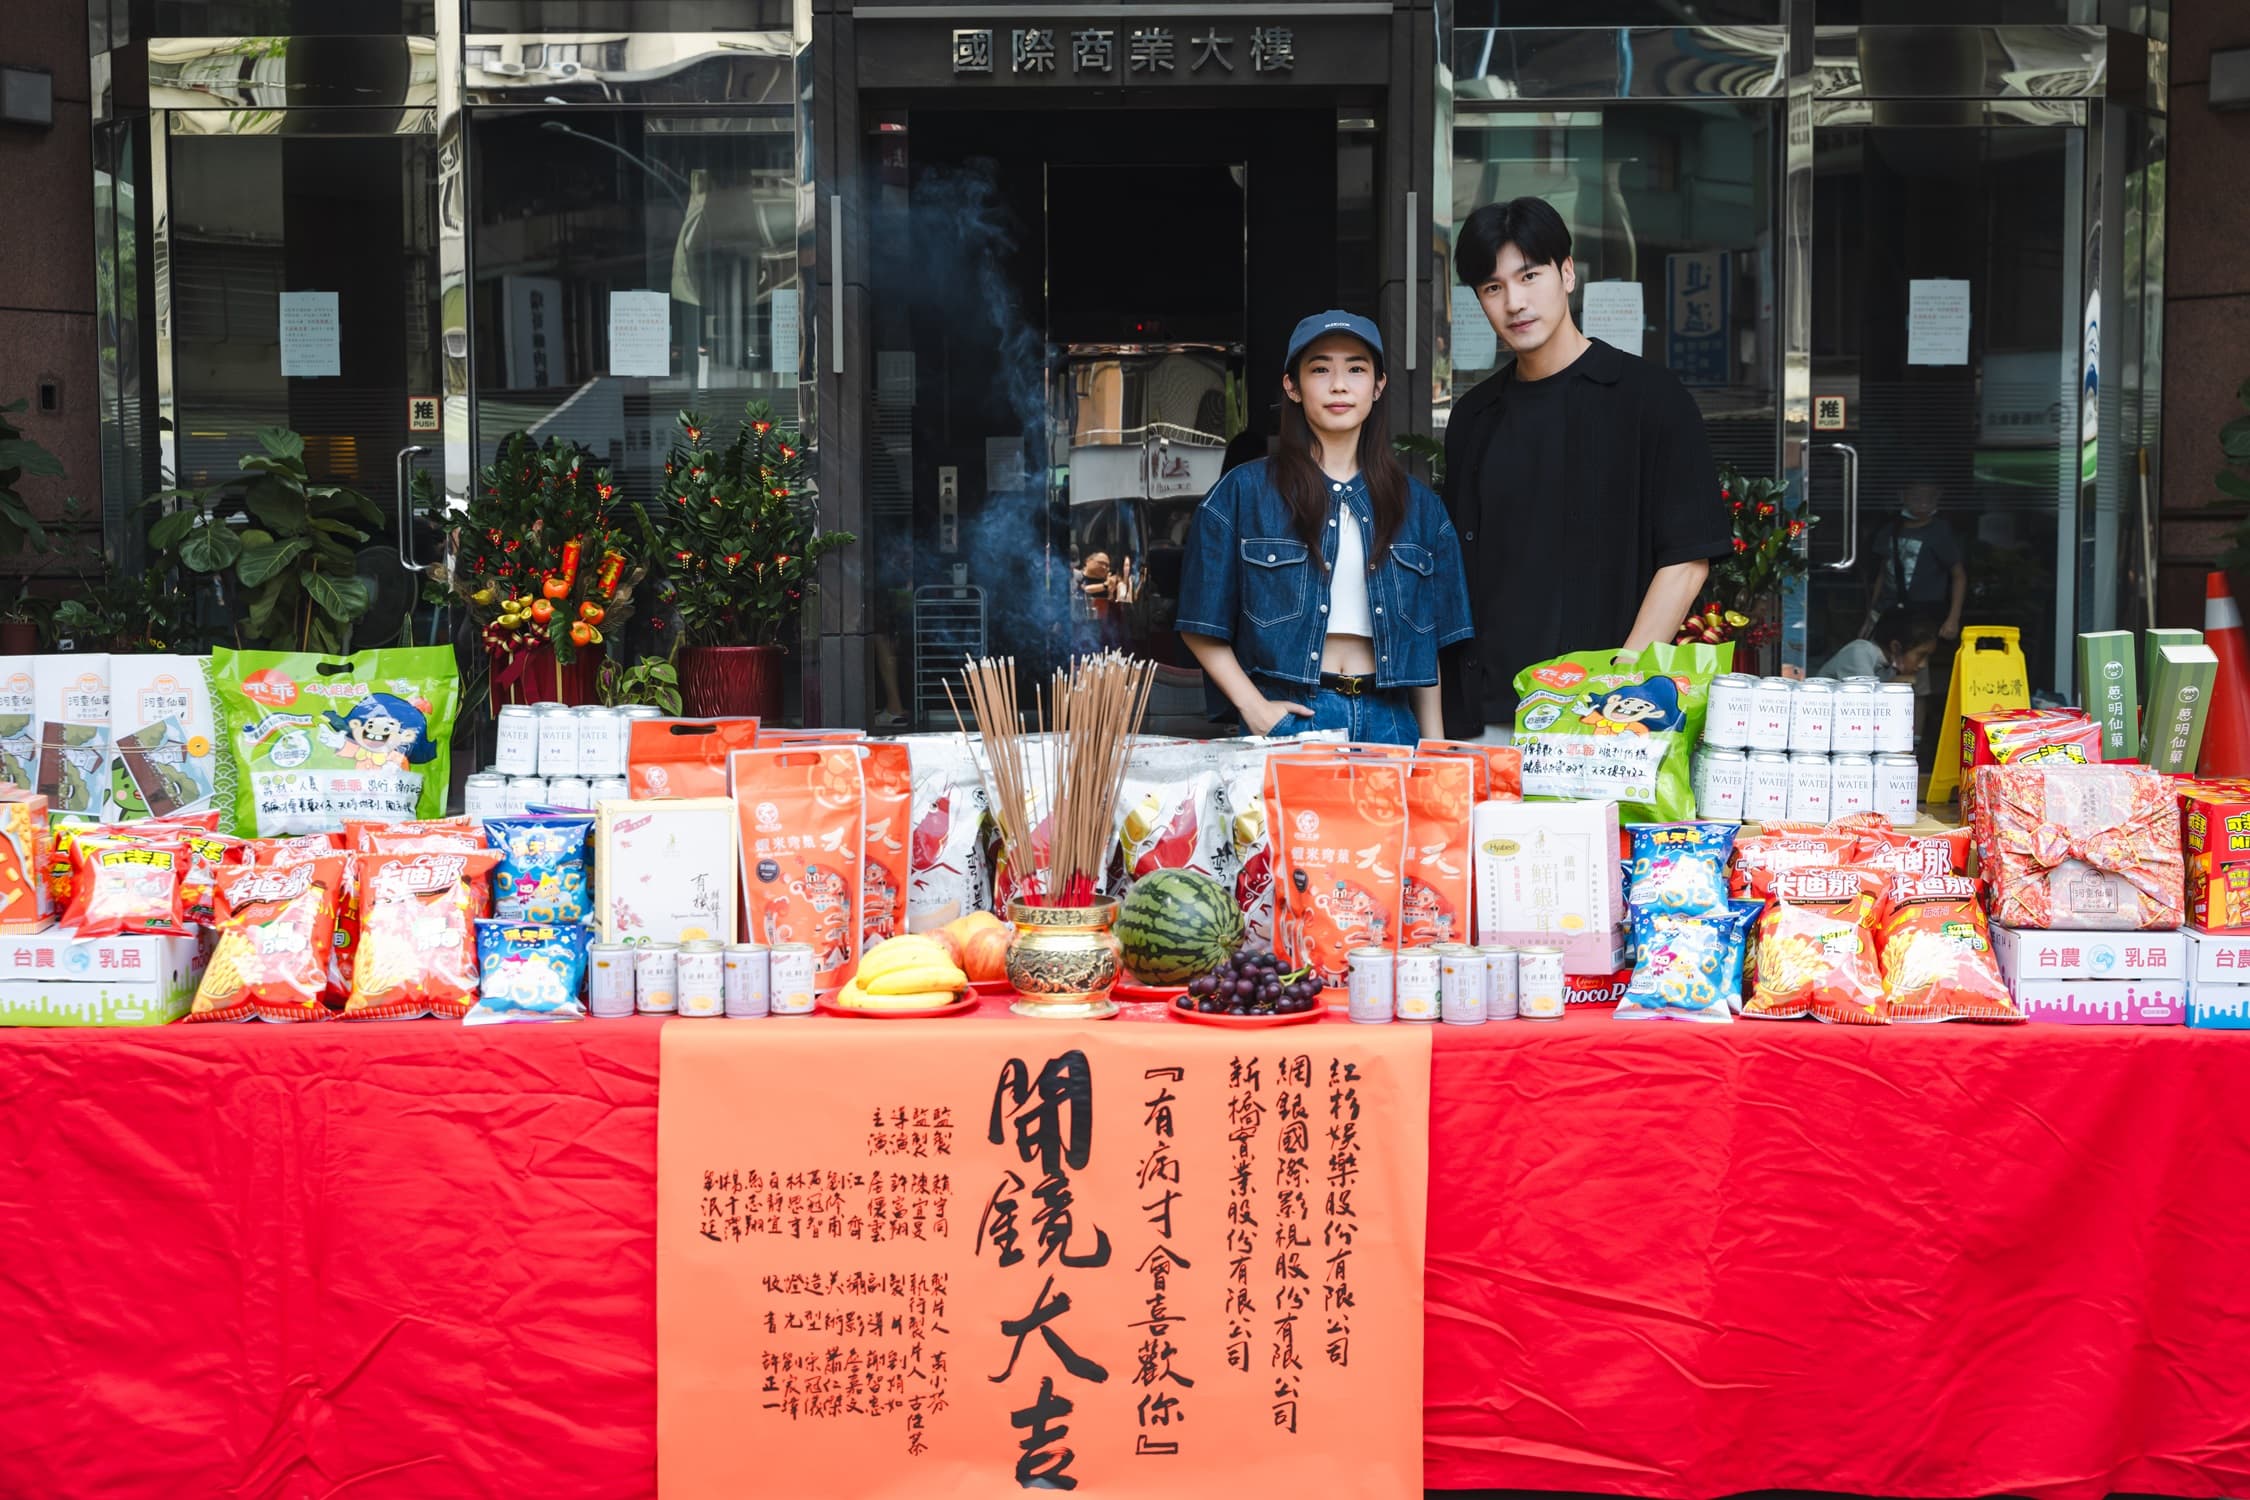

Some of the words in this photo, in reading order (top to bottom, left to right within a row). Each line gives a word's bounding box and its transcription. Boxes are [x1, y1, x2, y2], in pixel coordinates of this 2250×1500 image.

[953, 27, 1295, 72] 國際商業大樓
[413, 420, 435, 428] PUSH
[414, 401, 434, 419] 推
[1820, 400, 1840, 418] 推
[1968, 680, 2024, 697] 小心地滑
[1840, 707, 1871, 716] WATER
[500, 732, 529, 741] WATER
[542, 732, 572, 741] WATER
[1712, 774, 1742, 784] WATER
[1837, 780, 1868, 789] WATER
[226, 866, 314, 905] 卡迪那
[1769, 871, 1861, 898] 卡迪那
[1889, 874, 1975, 902] 卡迪那
[13, 948, 56, 968] 台農
[98, 948, 142, 969] 乳品
[2039, 948, 2081, 968] 台農
[2125, 948, 2167, 968] 乳品
[867, 1107, 889, 1157] 主演
[889, 1105, 910, 1155] 導演
[912, 1107, 931, 1158] 監製
[933, 1106, 954, 1156] 監製
[1272, 1054, 1312, 1434] 網銀國際影視股份有限公司
[975, 1050, 1113, 1492] 開鏡大吉
[804, 1273, 824, 1331] 造型
[824, 1270, 844, 1337] 美術
[844, 1271, 867, 1337] 攝影
[866, 1272, 886, 1337] 副導
[930, 1272, 951, 1335] 製片人
[761, 1350, 781, 1409] 許正一
